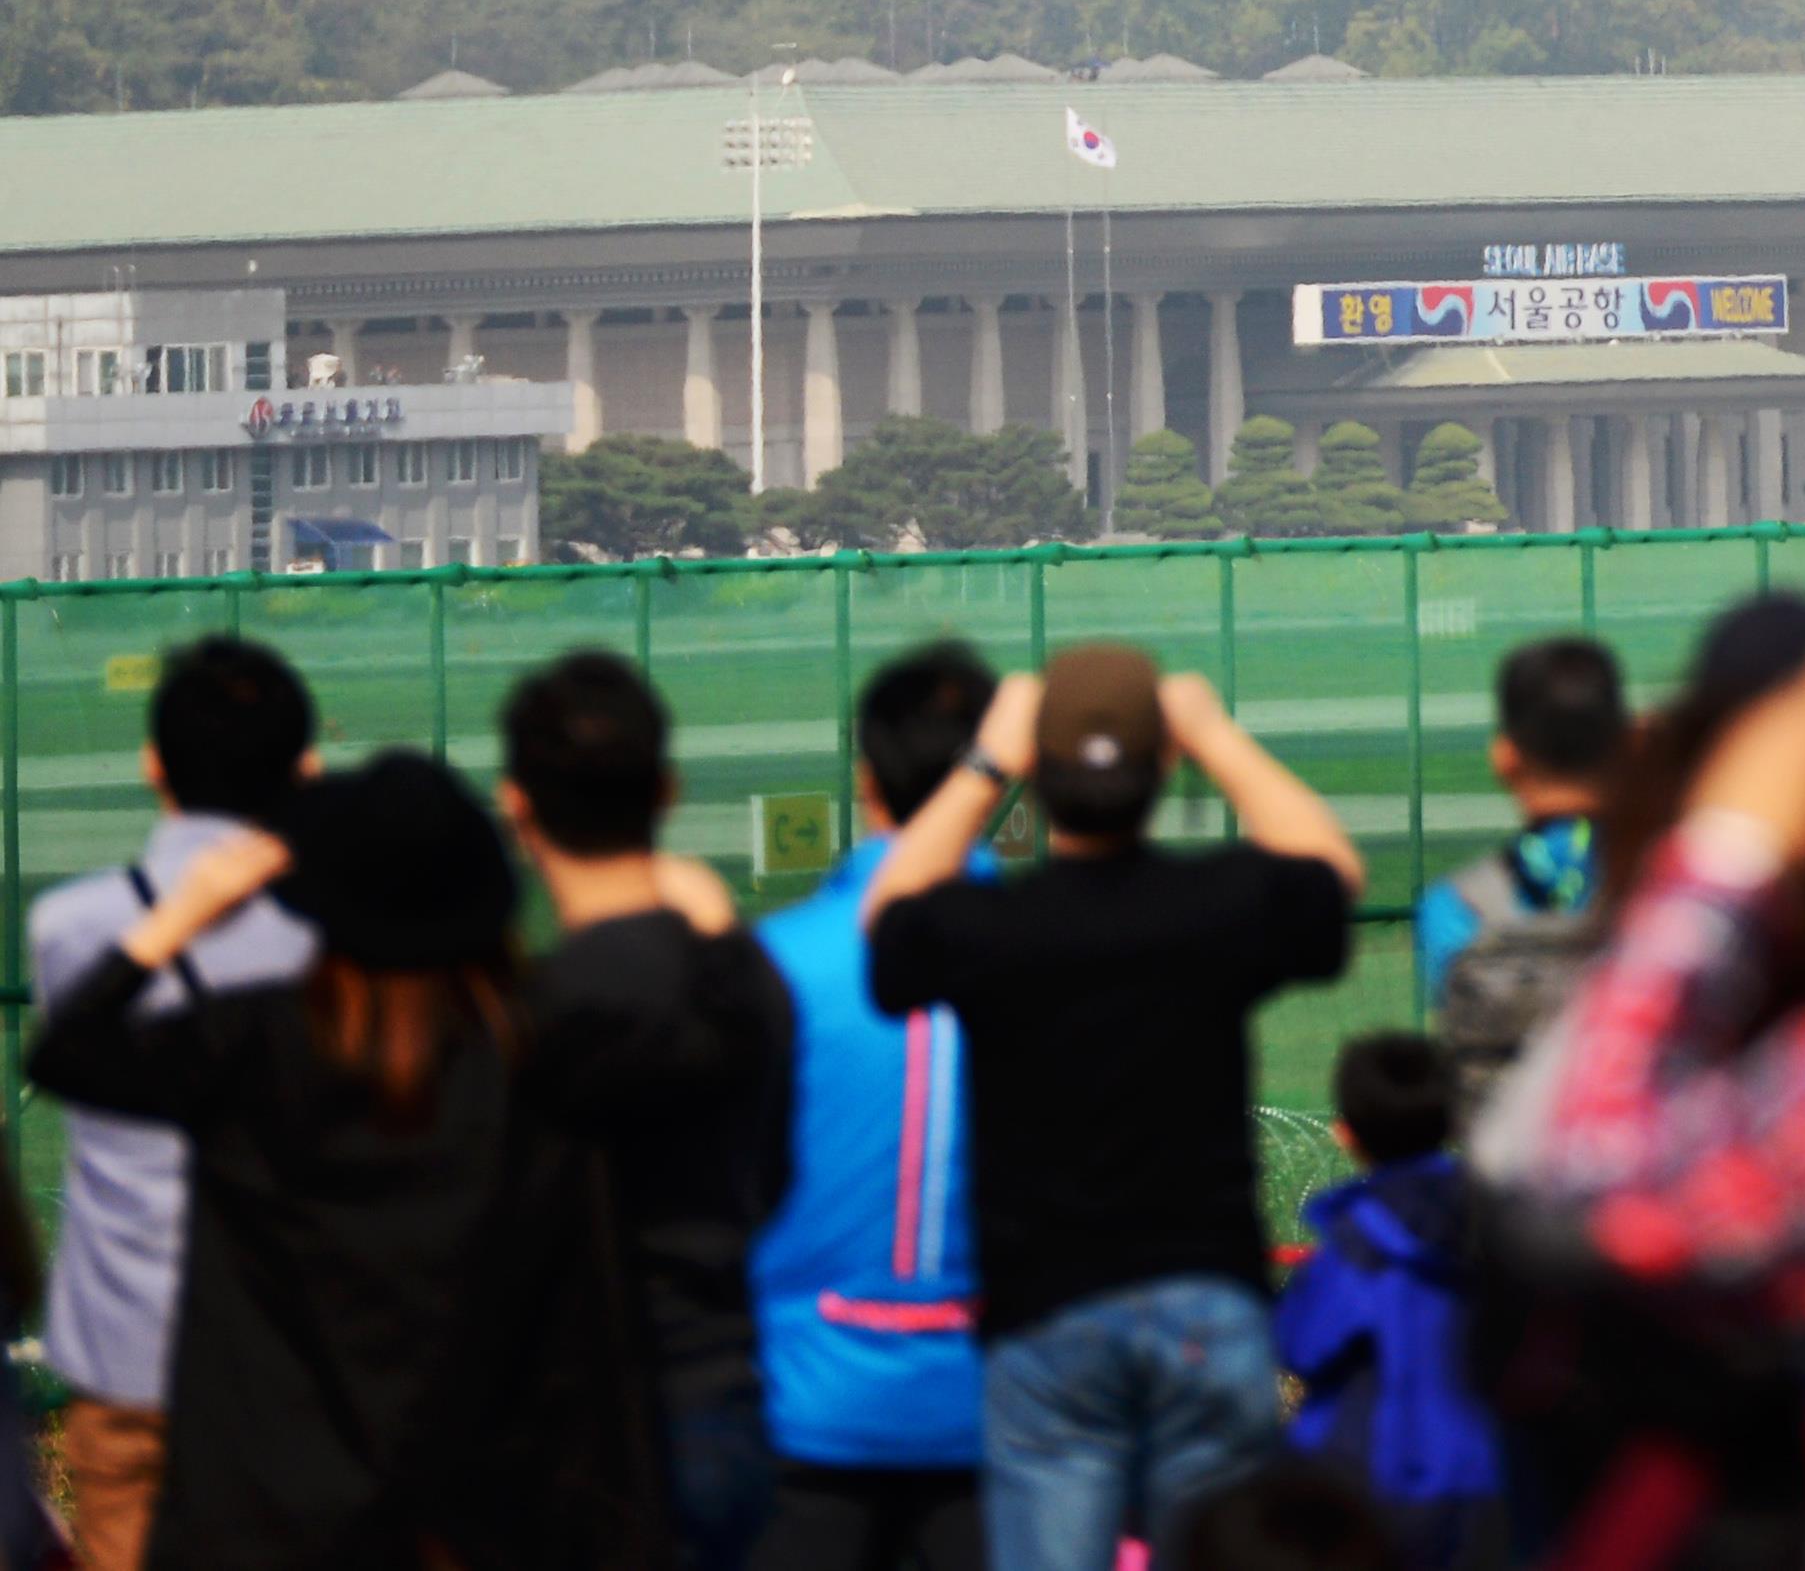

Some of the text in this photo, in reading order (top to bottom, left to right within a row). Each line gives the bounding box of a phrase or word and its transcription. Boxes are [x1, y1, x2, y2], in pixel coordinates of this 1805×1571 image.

[1339, 293, 1392, 334] 환영
[1487, 286, 1625, 331] 서울공항
[1711, 285, 1776, 323] WELCOME
